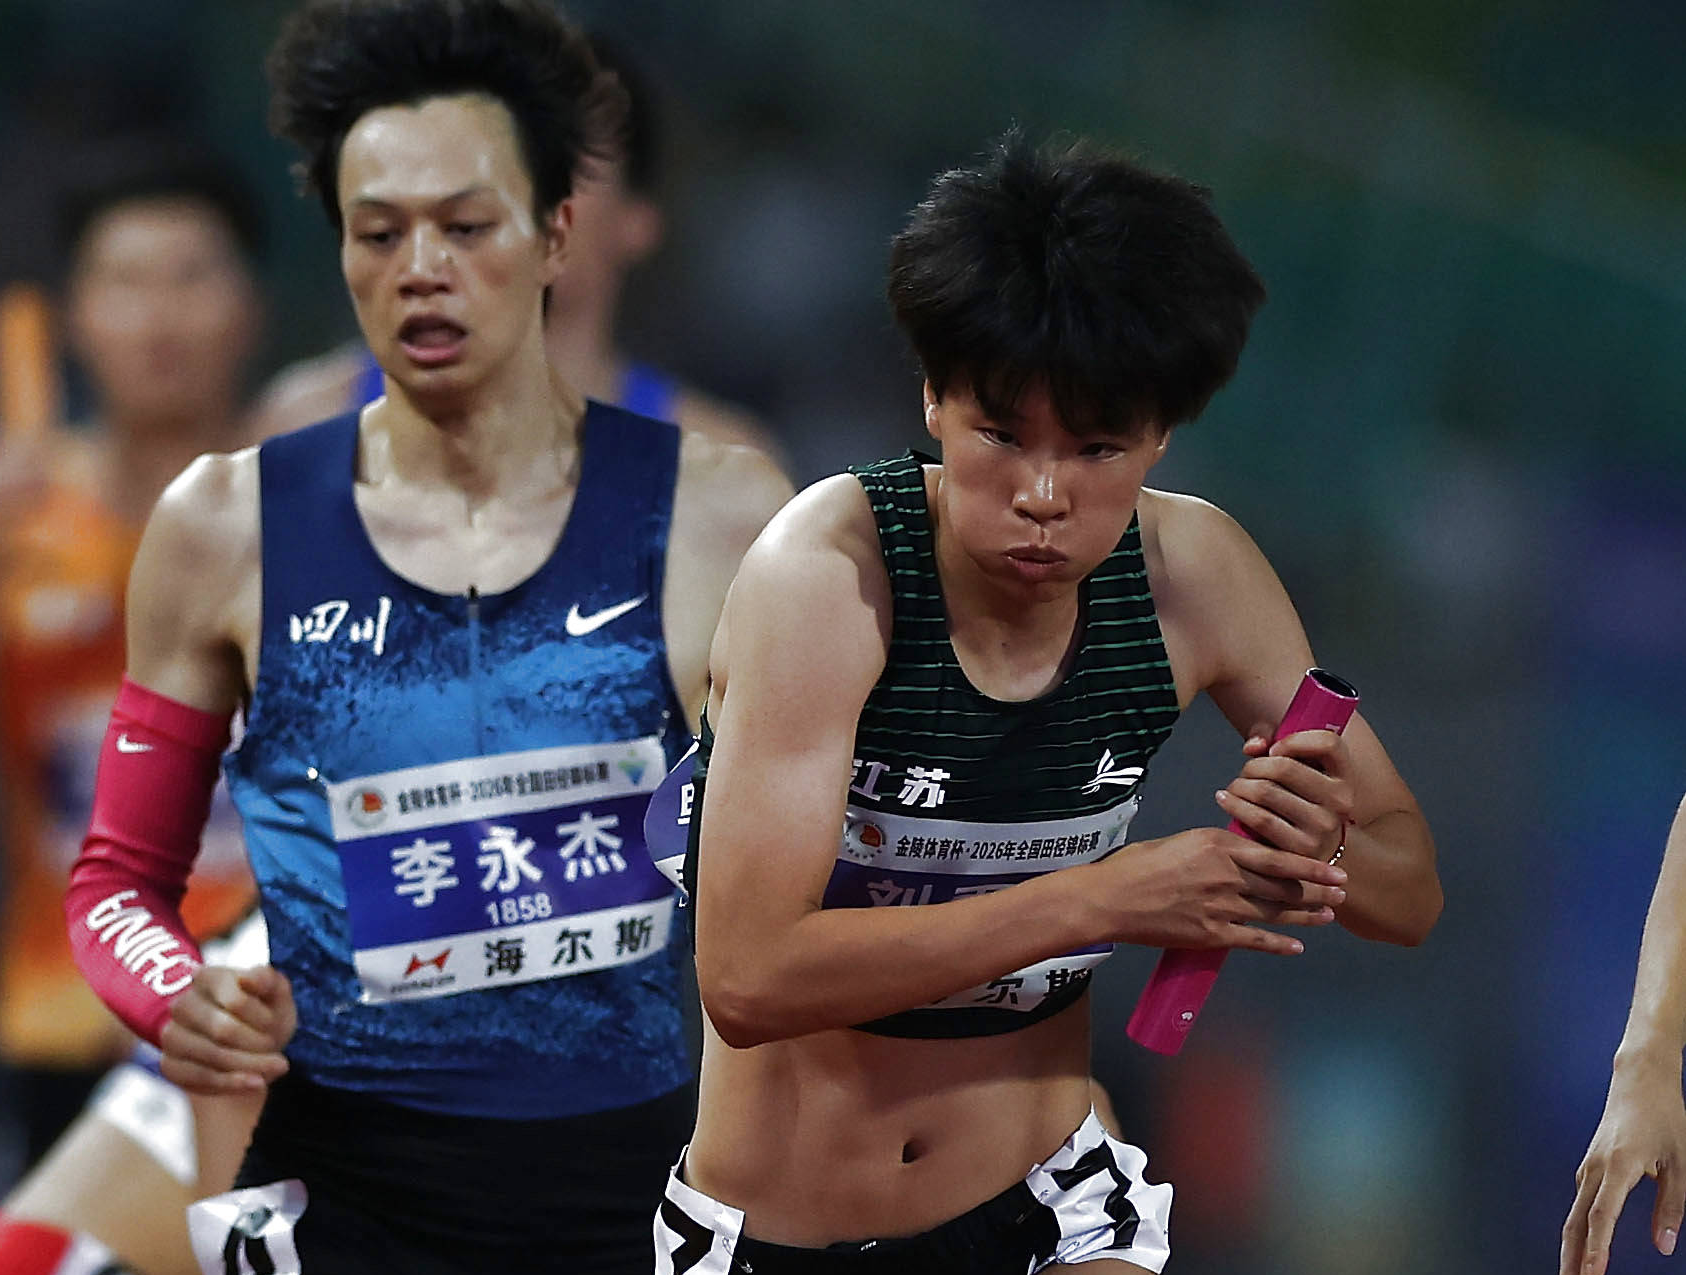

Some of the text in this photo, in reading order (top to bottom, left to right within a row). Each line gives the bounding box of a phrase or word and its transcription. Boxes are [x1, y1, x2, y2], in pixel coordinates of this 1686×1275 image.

[289, 596, 393, 656] 四川
[847, 758, 951, 808] 江苏
[391, 811, 628, 908] 李永杰
[894, 830, 1102, 862] 金陵体育杯·2026年全国田径锦标赛
[485, 892, 553, 926] 1858
[85, 889, 199, 996] CHINA
[483, 915, 654, 978] 海尔斯
[1050, 1140, 1139, 1249] 7
